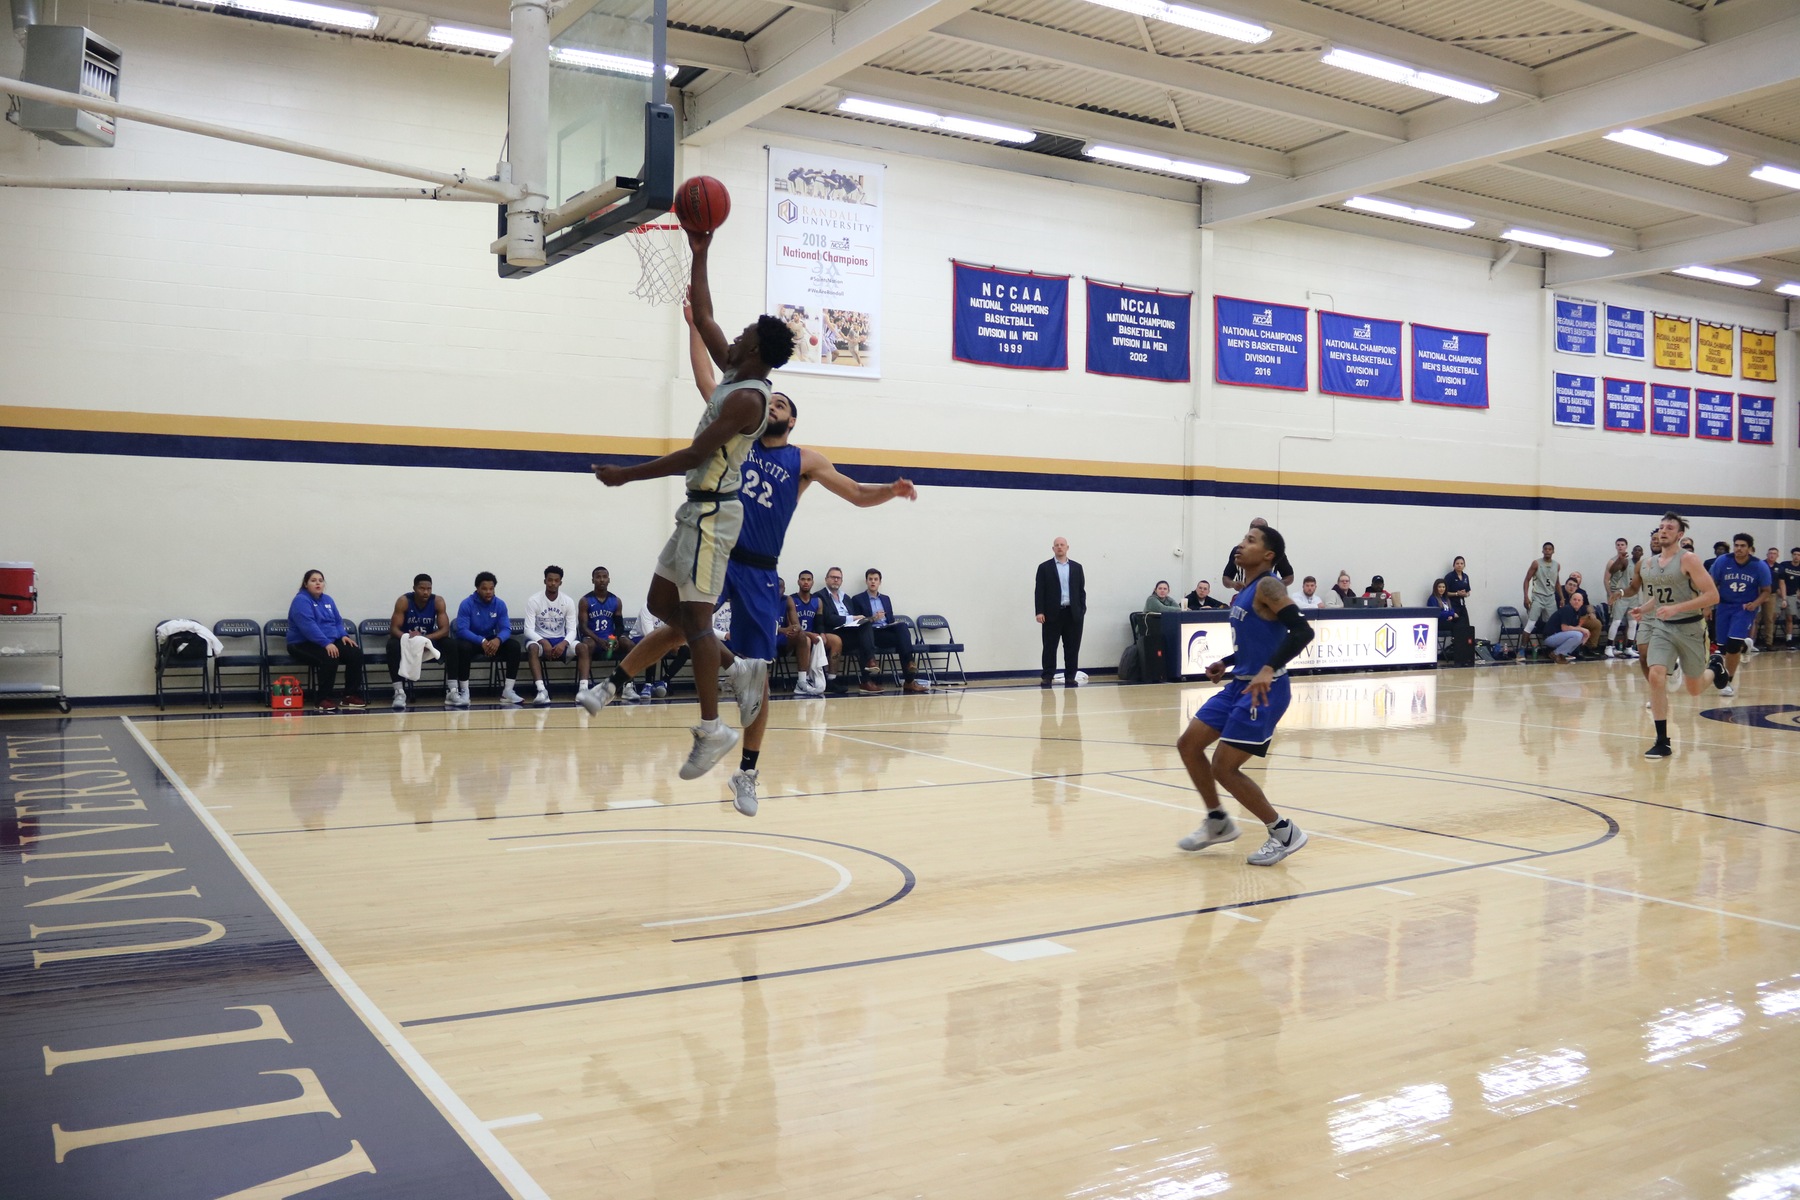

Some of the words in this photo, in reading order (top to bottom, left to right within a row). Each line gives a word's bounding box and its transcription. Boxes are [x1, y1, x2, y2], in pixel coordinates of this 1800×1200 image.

[802, 206, 860, 222] RANDALL
[802, 216, 871, 232] UNIVERSITY
[802, 232, 827, 248] 2018
[783, 246, 820, 260] National
[822, 251, 868, 267] Champions
[982, 282, 1042, 302] NCCAA
[970, 298, 1003, 312] NATIONAL
[1010, 302, 1049, 316] CHAMPIONS
[1120, 298, 1160, 316] NCCAA
[984, 312, 1034, 327] BASKETBALL
[1106, 313, 1138, 325] NATIONAL
[1139, 316, 1176, 330] CHAMPIONS
[1253, 315, 1272, 324] NCCAA
[978, 326, 1006, 340] DIVISION
[1022, 331, 1038, 341] MEN
[1118, 325, 1162, 340] BASKETBALL
[1222, 325, 1260, 338] NATIONAL
[1260, 330, 1303, 342] CHAMPIONS
[1353, 330, 1371, 338] NCCAA
[999, 343, 1023, 354] 1999
[1112, 337, 1141, 349] DIVISION
[1153, 342, 1168, 352] MEN
[1227, 338, 1250, 350] MEN'S
[1251, 342, 1298, 354] BASKETBALL
[1326, 338, 1358, 350] NATIONAL
[1359, 343, 1396, 354] CHAMPIONS
[1130, 352, 1148, 362] 2002
[1245, 353, 1275, 364] DIVISION
[1276, 355, 1282, 364] II
[1330, 351, 1351, 360] MEN'S
[1352, 354, 1393, 366] BASKETBALL
[1418, 350, 1447, 361] NATIONAL
[1448, 354, 1482, 365] CHAMPIONS
[1255, 367, 1271, 376] 2016
[1346, 365, 1372, 375] DIVISION
[1374, 367, 1379, 376] II
[1422, 362, 1441, 371] MEN'S
[1442, 364, 1479, 375] BASKETBALL
[1356, 379, 1369, 387] 2017
[1436, 375, 1459, 384] DIVISION
[1461, 376, 1466, 385] II
[1445, 388, 1458, 396] 2018
[764, 462, 790, 483] CITY
[742, 470, 772, 508] 22
[1741, 574, 1754, 583] CITY
[1730, 582, 1746, 592] 42
[1657, 588, 1674, 603] 22
[595, 620, 608, 631] 13
[802, 620, 808, 631] 5
[284, 698, 292, 706] G
[6, 734, 226, 970] UNIVERSITY
